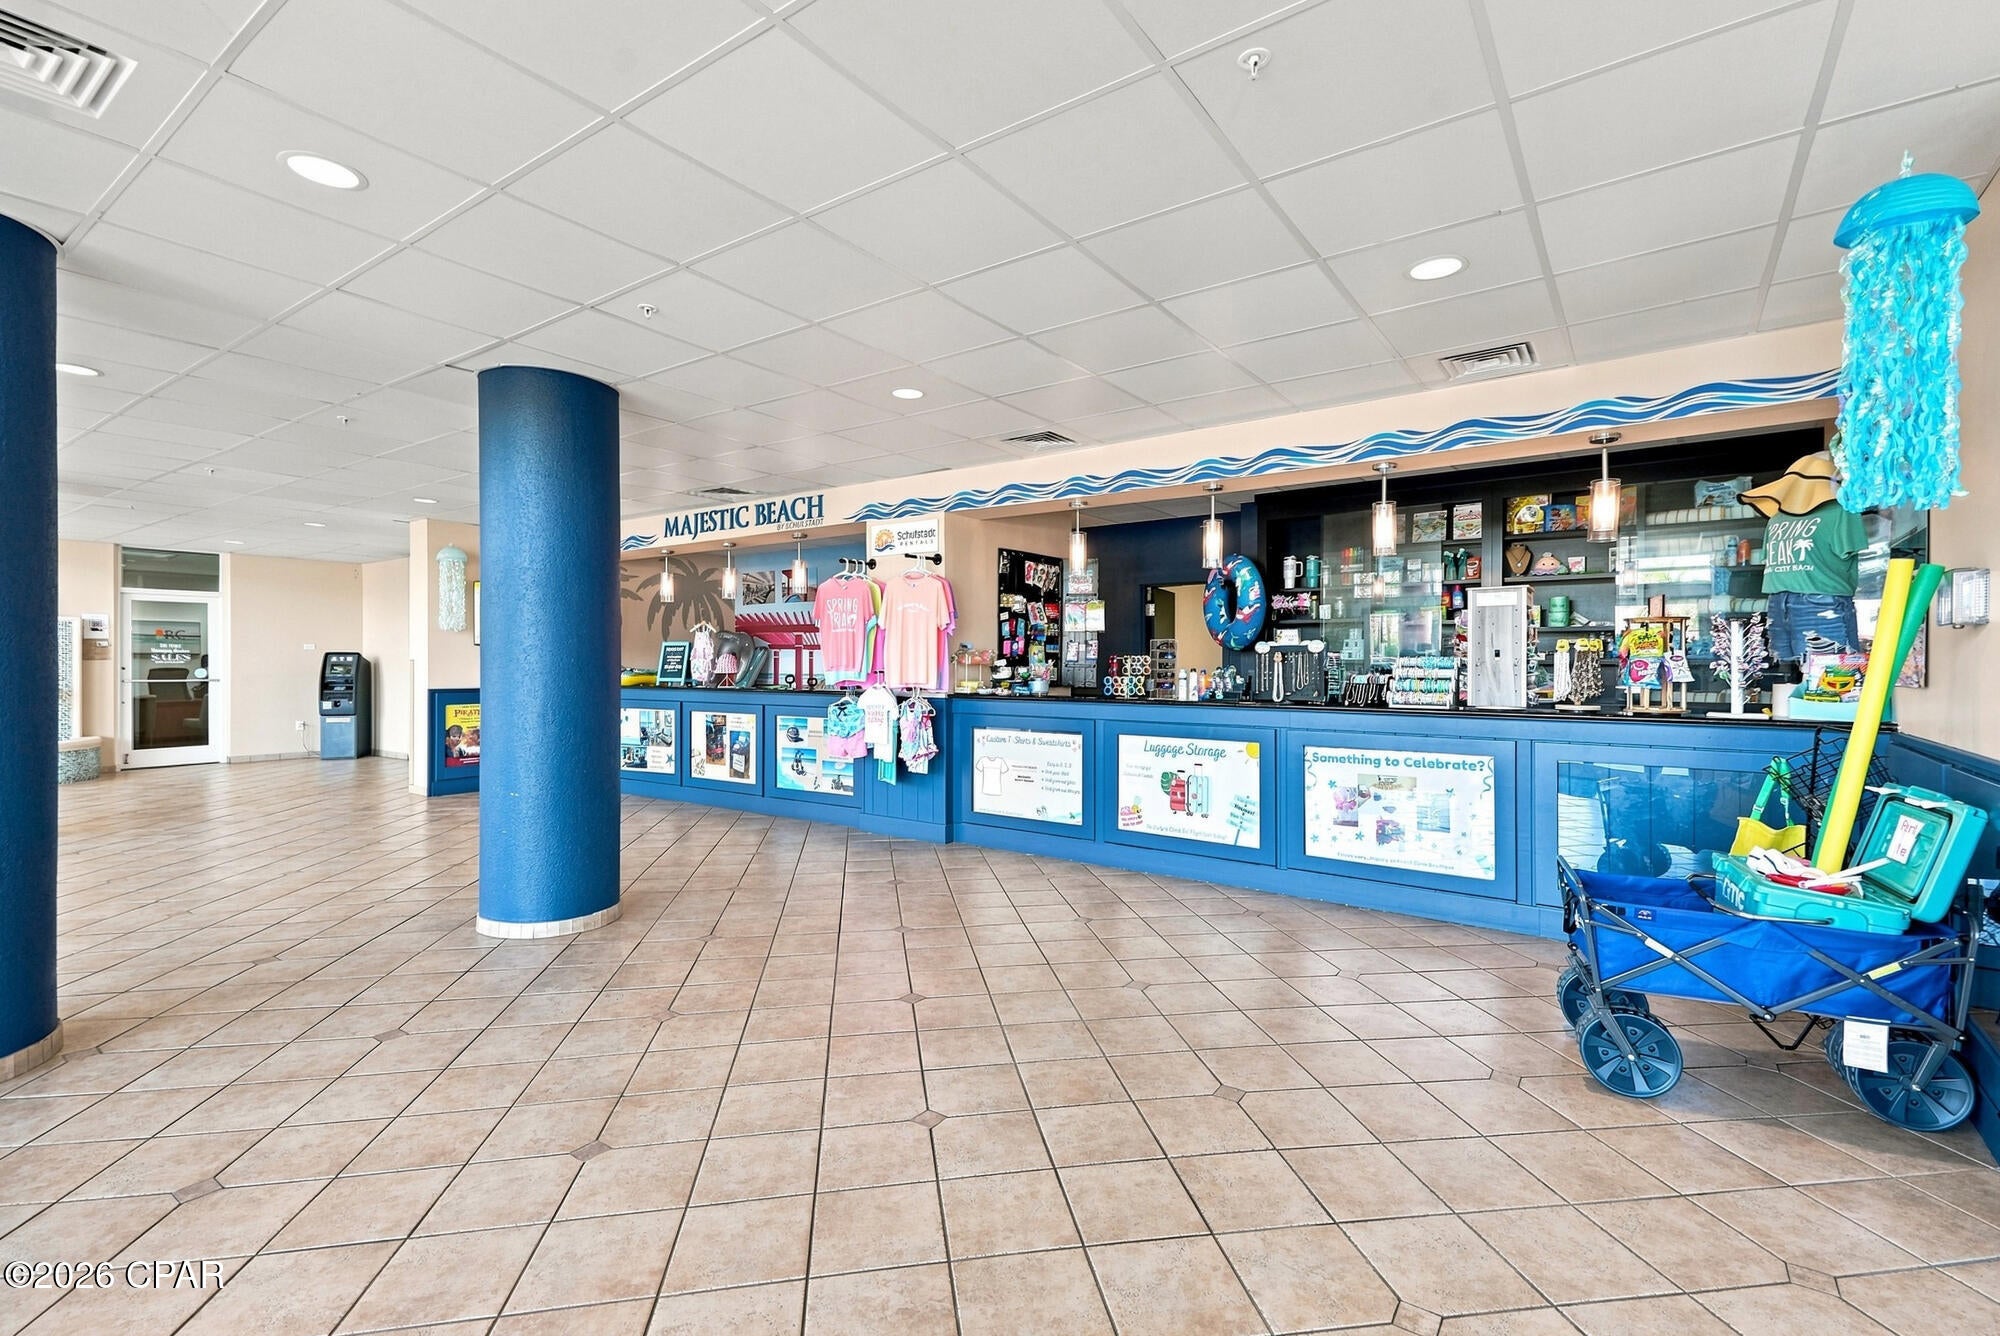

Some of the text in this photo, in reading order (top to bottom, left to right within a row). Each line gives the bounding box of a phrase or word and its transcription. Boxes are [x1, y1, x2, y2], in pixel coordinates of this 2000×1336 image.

[664, 494, 825, 540] MAJESTIC BEACH
[776, 523, 785, 531] BY
[1768, 517, 1821, 541] PRING
[826, 598, 858, 614] SPRING
[1144, 740, 1227, 762] Luggage Storage
[1312, 752, 1486, 772] Something to Celebrate?
